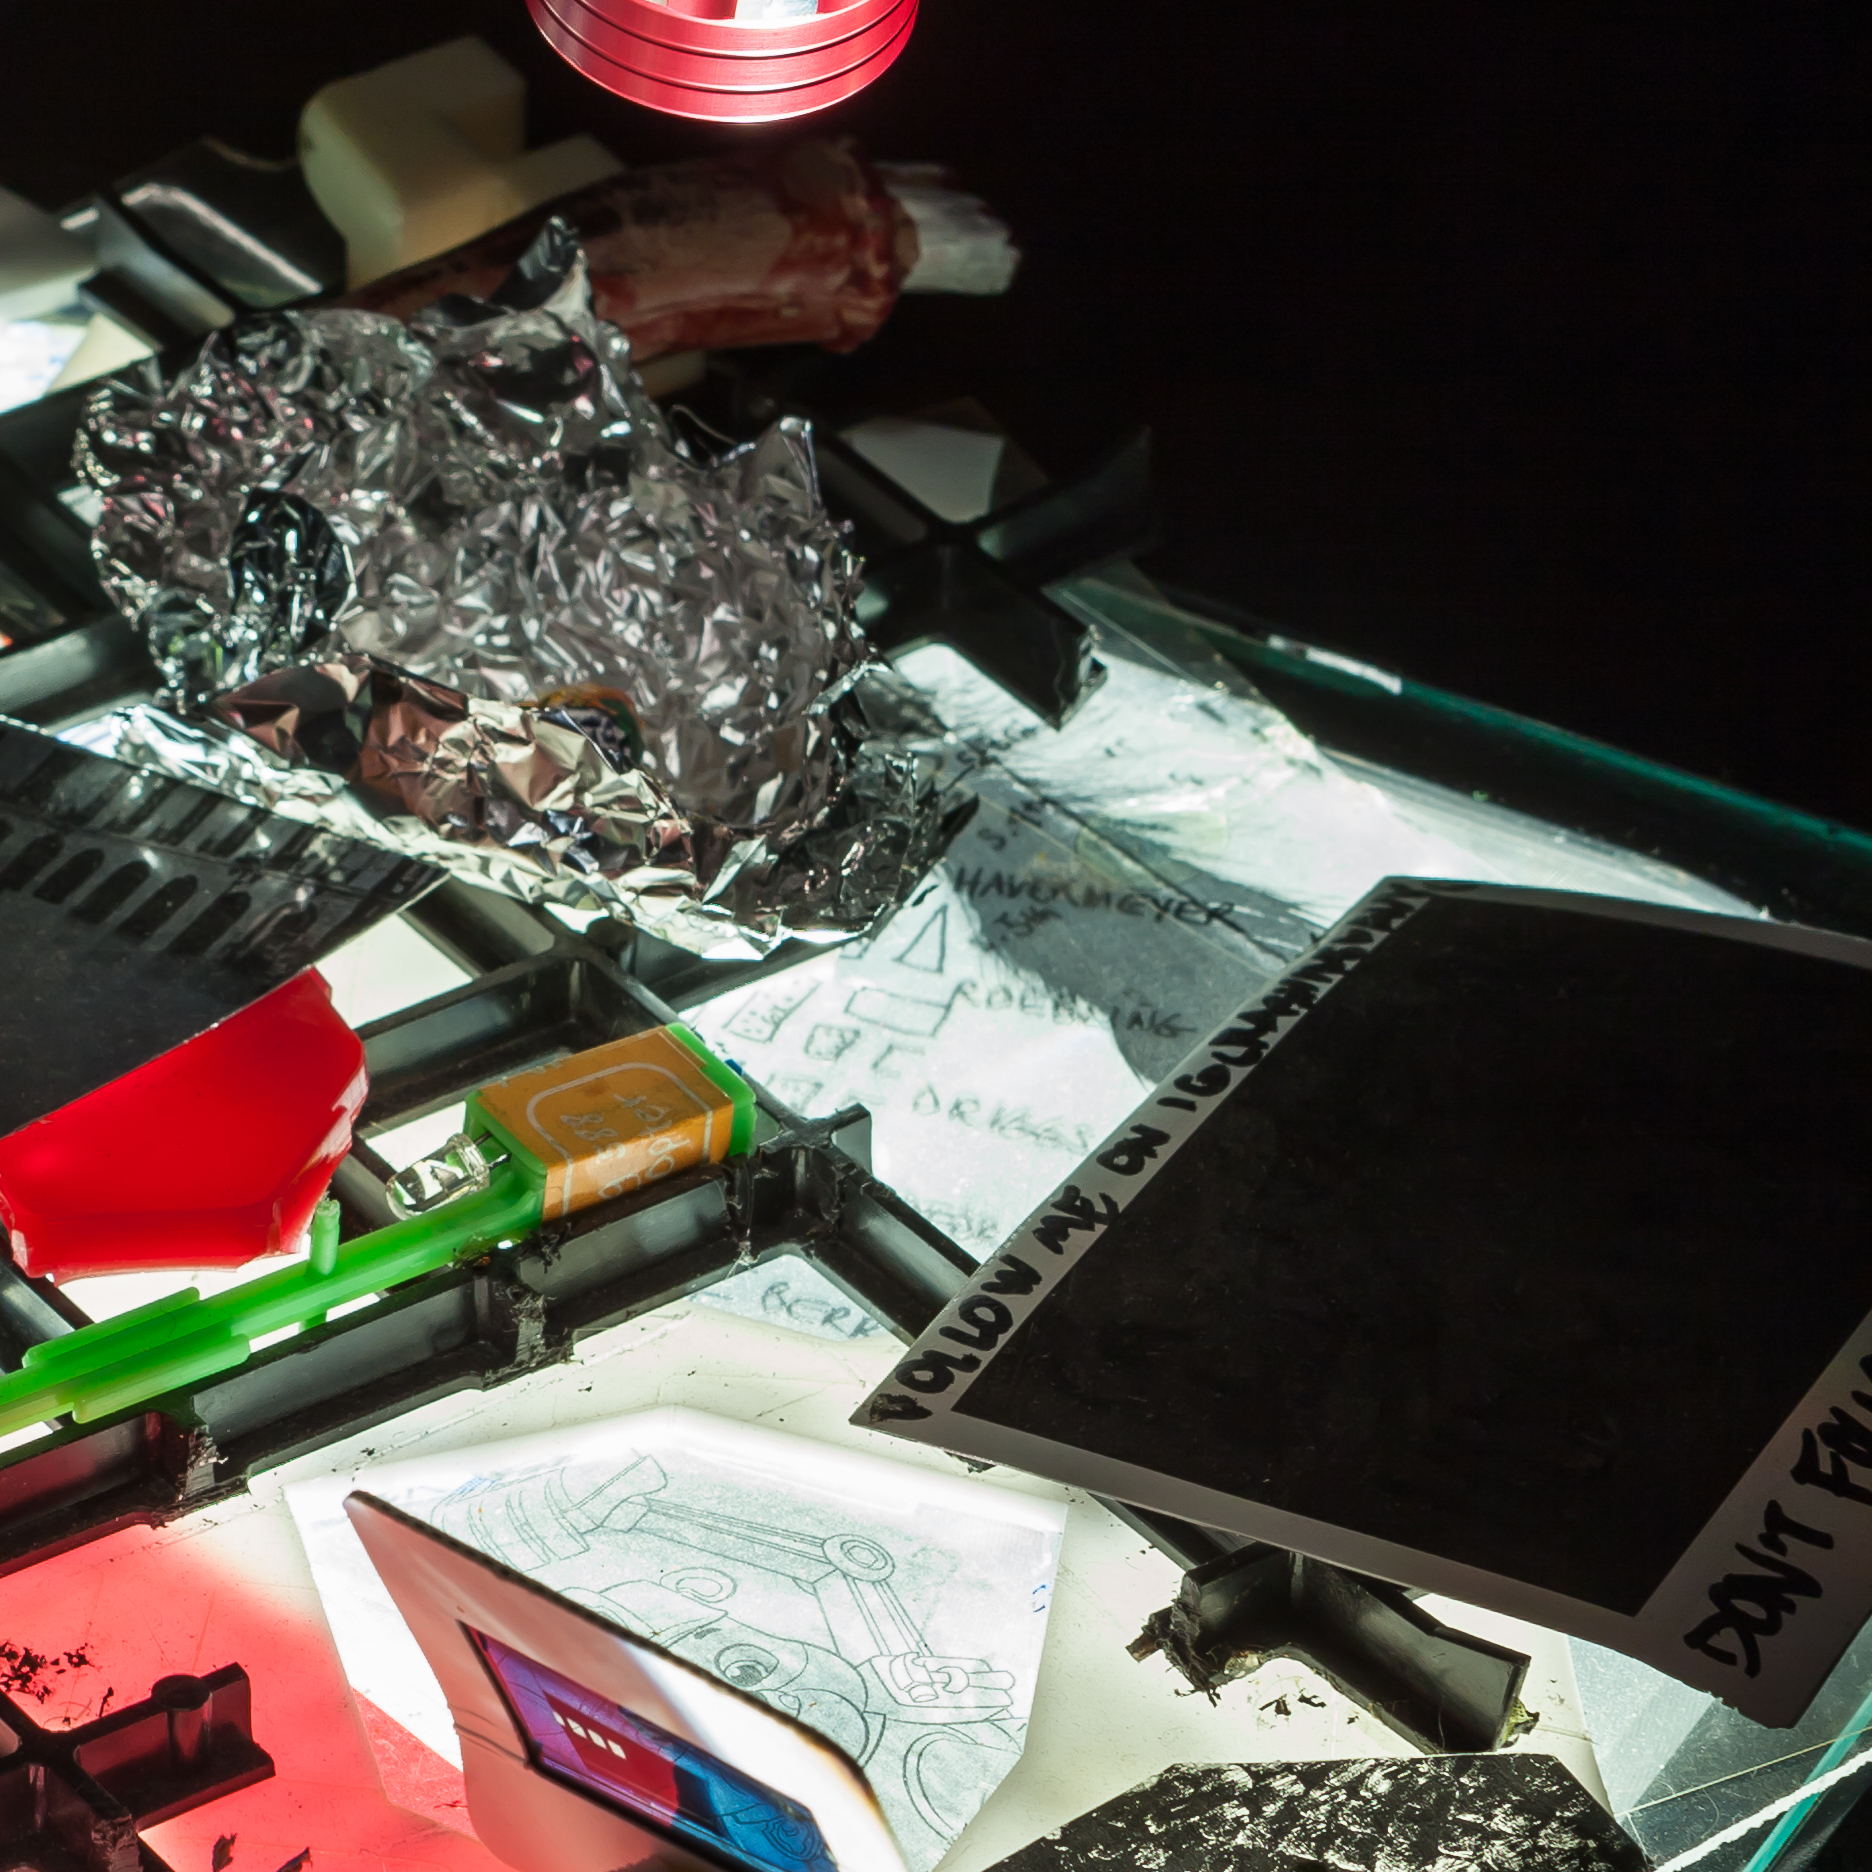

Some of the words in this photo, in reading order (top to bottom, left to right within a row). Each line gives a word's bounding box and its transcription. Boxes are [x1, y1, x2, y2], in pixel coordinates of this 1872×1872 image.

[868, 1253, 1043, 1422] FOLLOW
[1096, 1123, 1171, 1176] ON
[1682, 1498, 1835, 1679] DON'T
